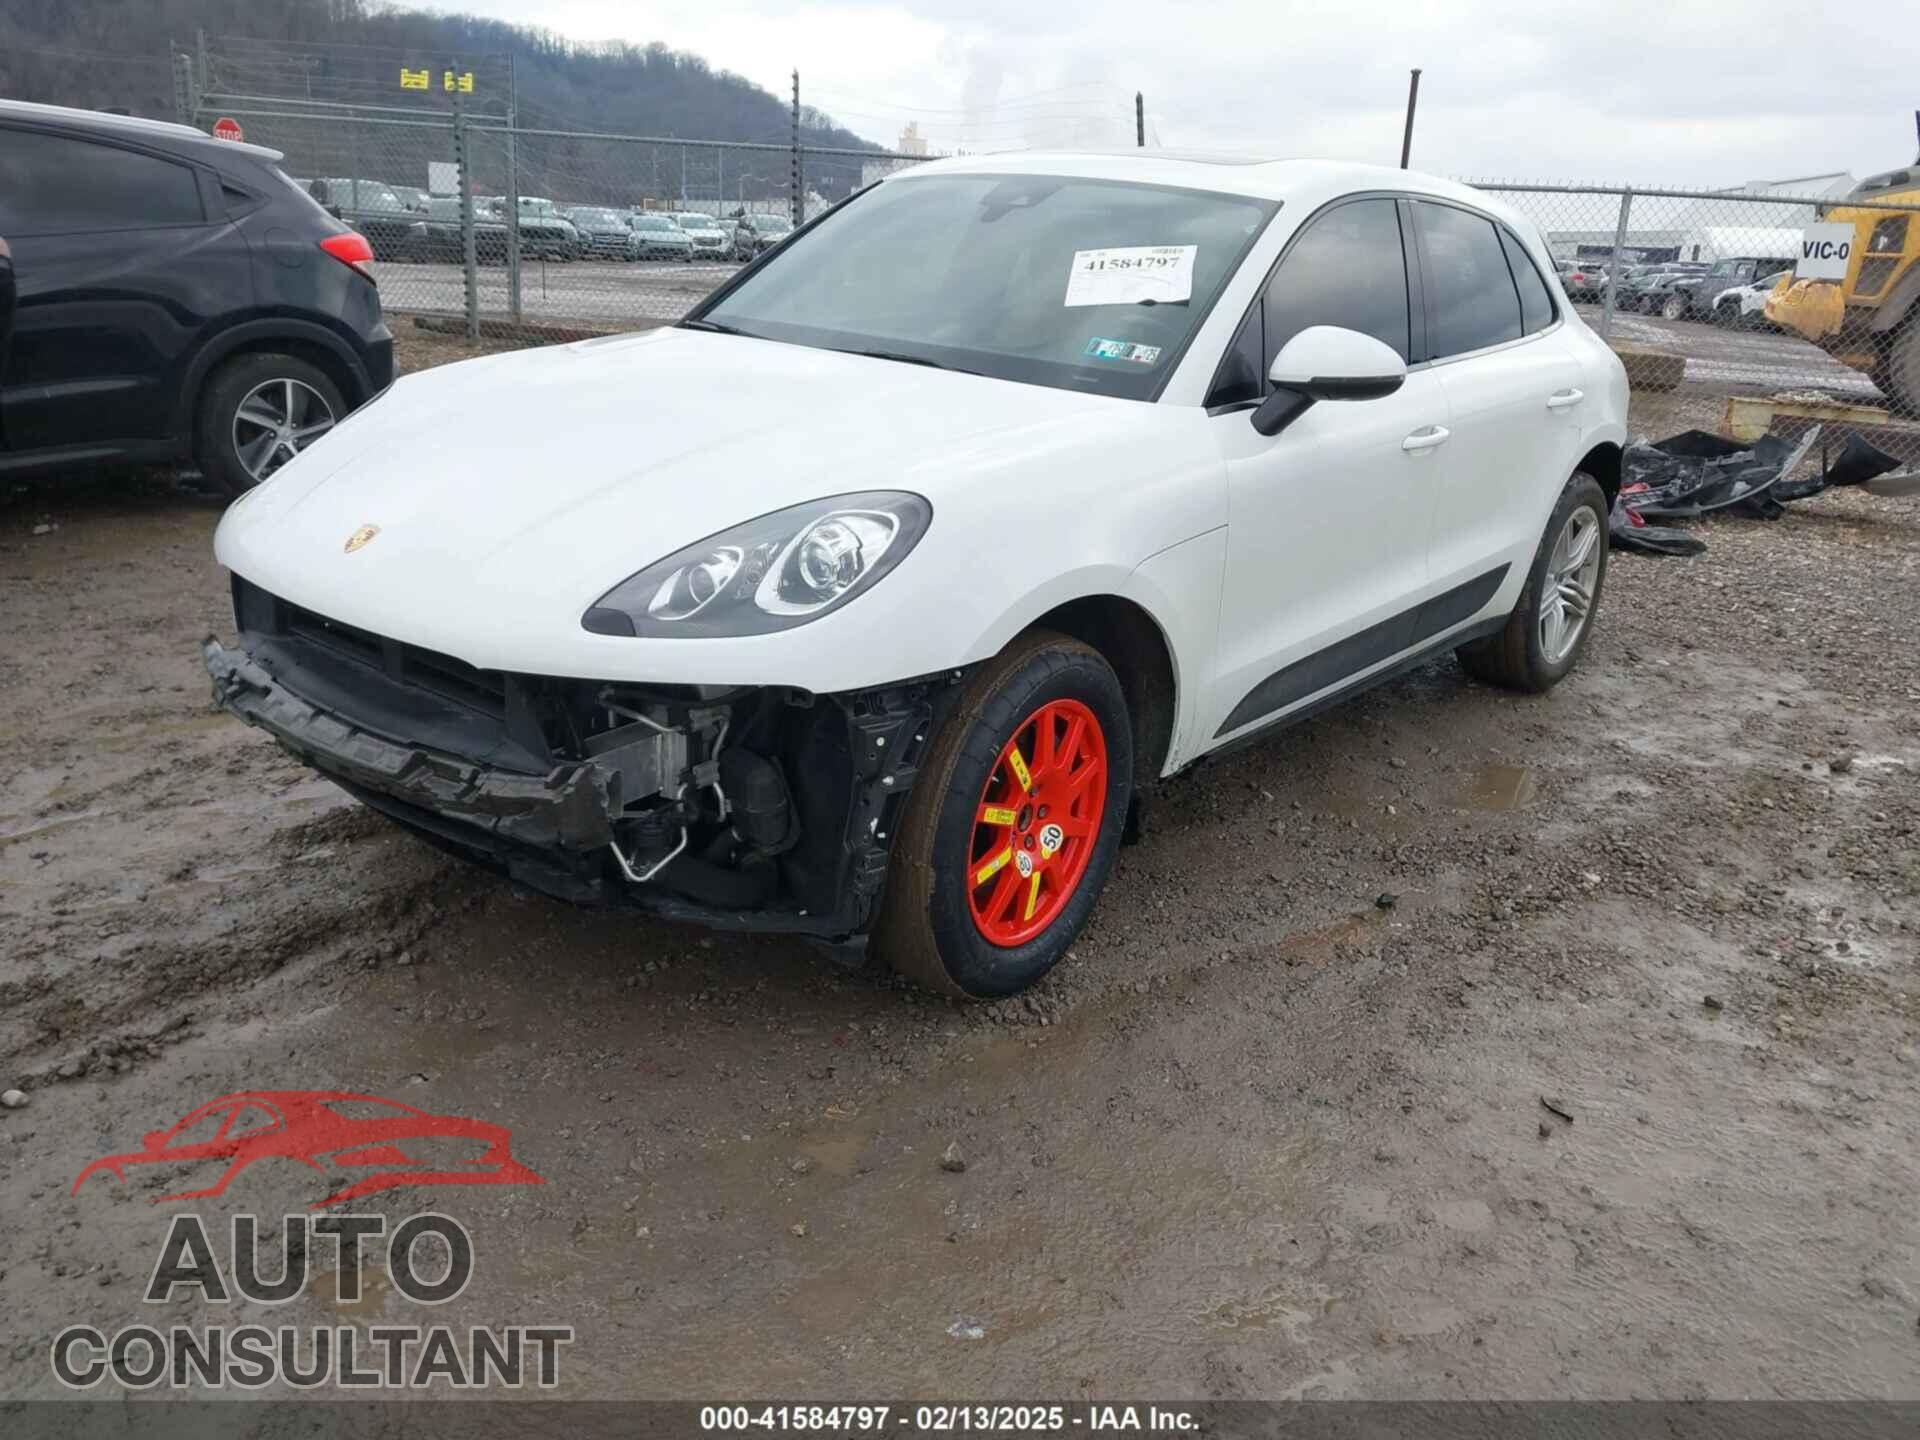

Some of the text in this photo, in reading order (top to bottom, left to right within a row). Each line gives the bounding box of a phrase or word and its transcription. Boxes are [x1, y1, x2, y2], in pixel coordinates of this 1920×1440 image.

[215, 129, 241, 142] STOP
[1803, 241, 1850, 260] VIC-0
[1084, 257, 1180, 270] 41584797
[1043, 826, 1061, 849] 50
